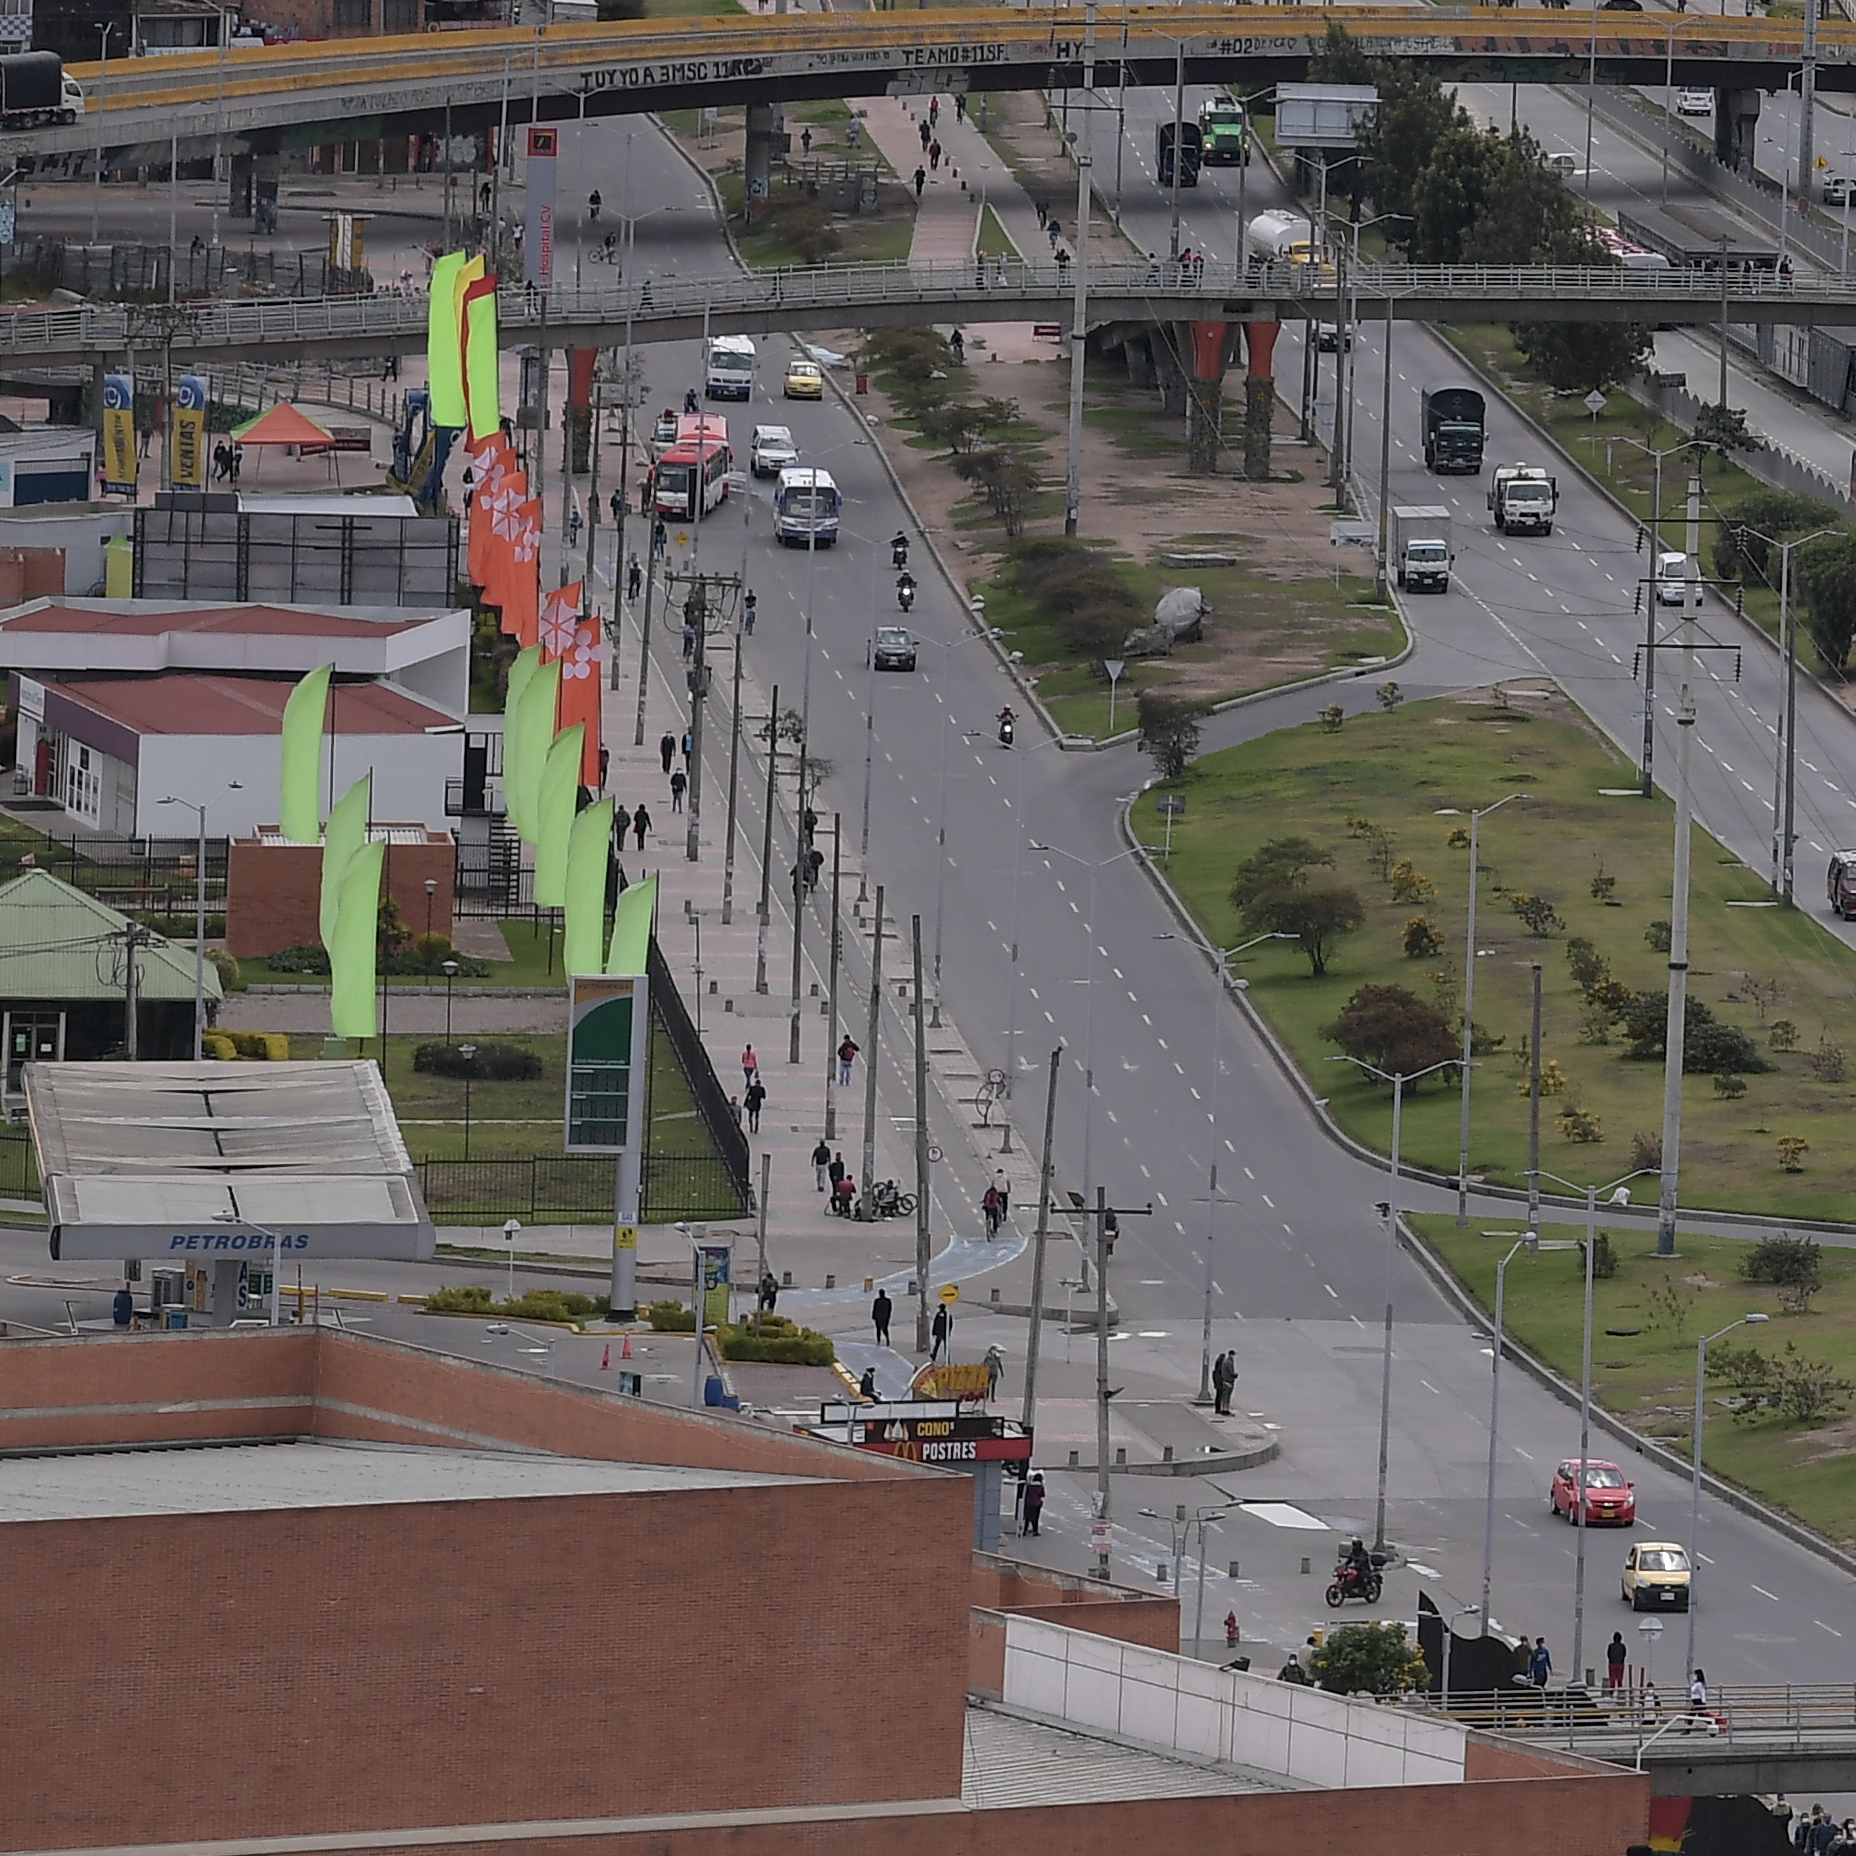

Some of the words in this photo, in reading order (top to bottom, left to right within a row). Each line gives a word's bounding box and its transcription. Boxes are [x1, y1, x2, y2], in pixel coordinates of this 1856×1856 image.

[169, 1233, 310, 1250] PETROBRAS
[936, 1365, 990, 1391] PIZZA
[922, 1442, 977, 1461] POSTRES
